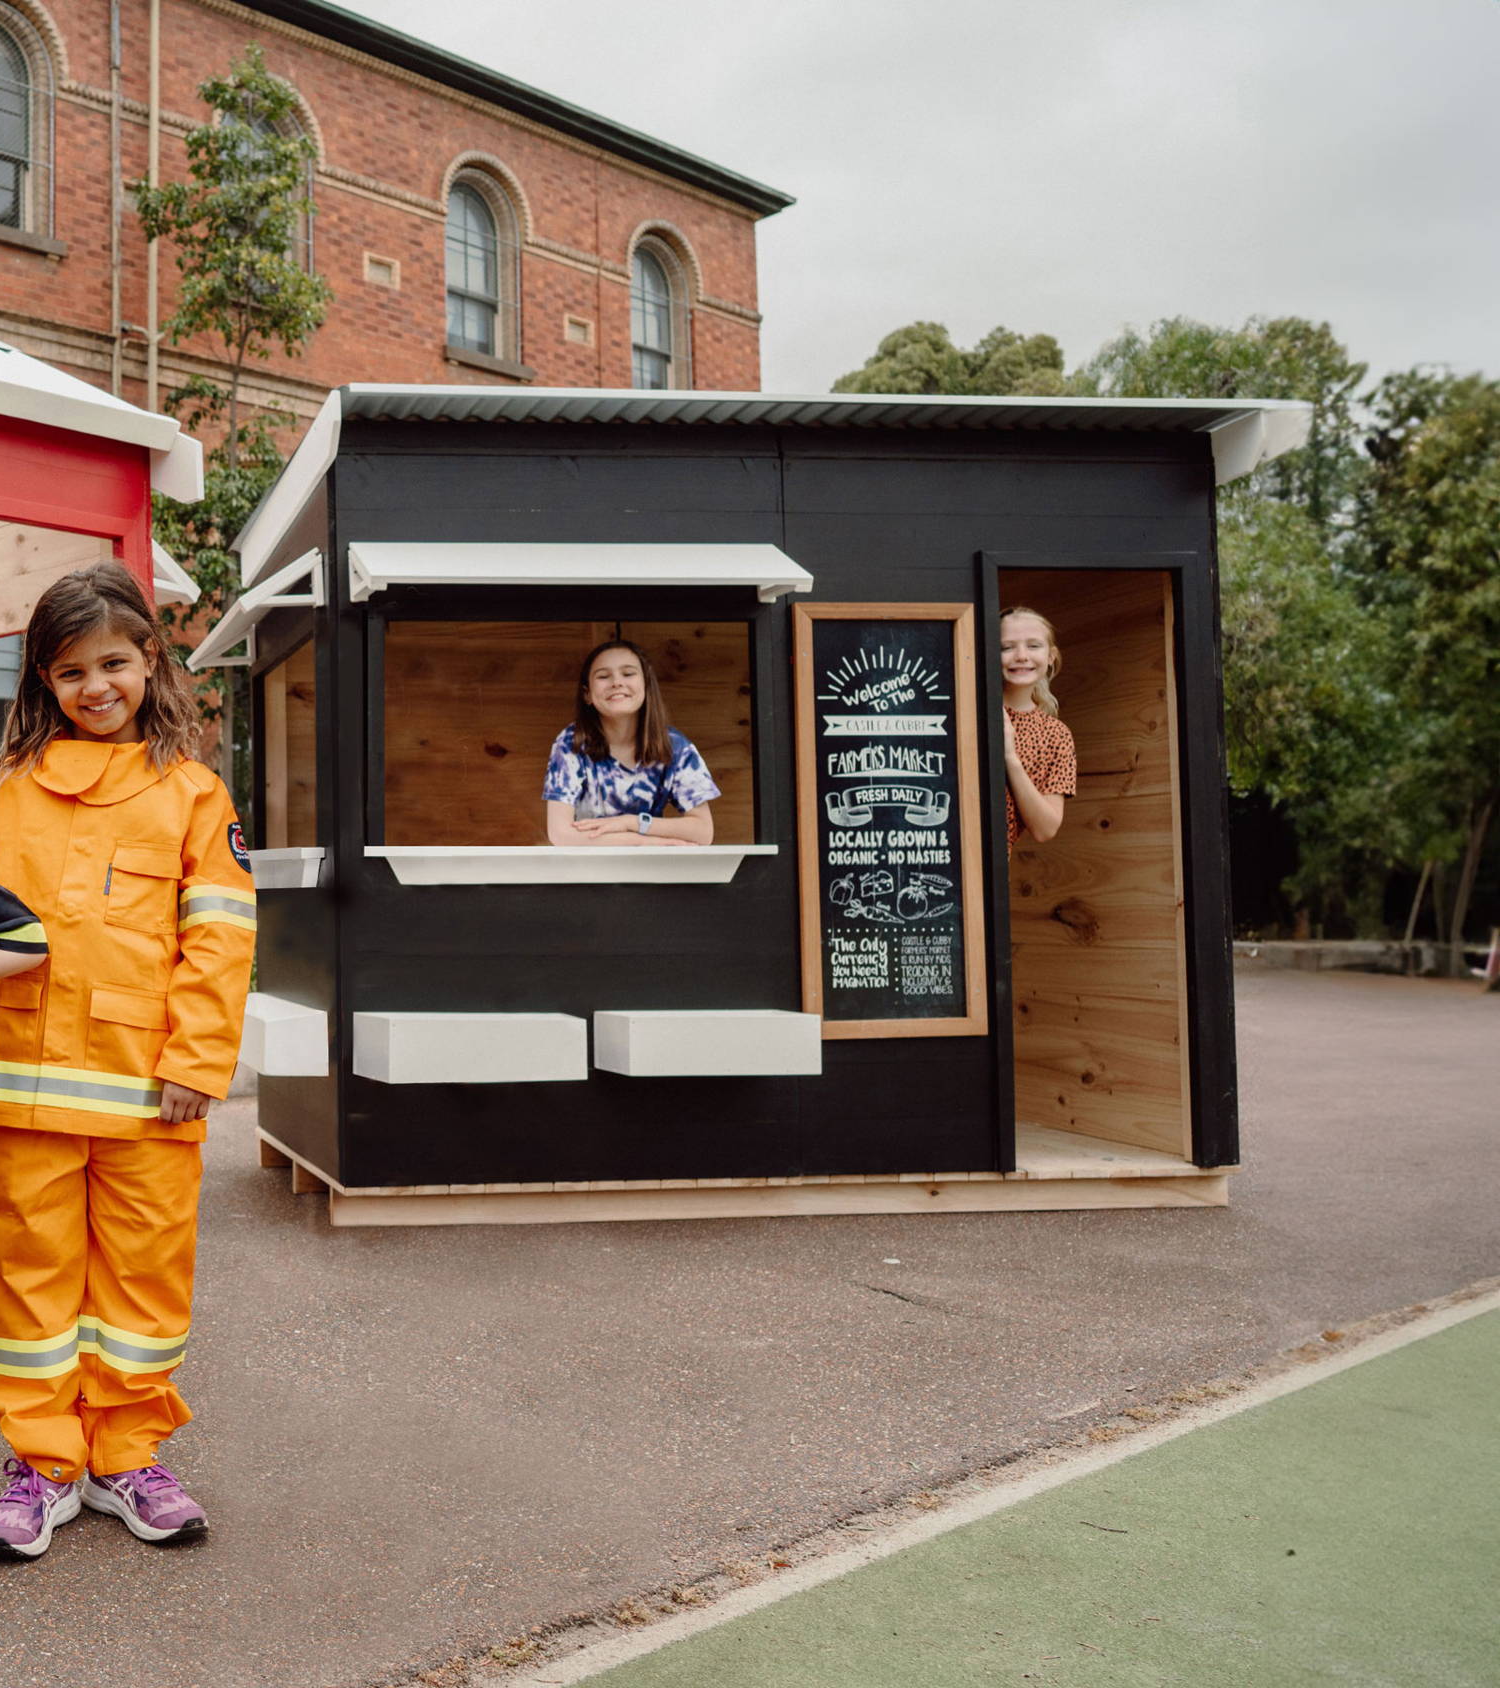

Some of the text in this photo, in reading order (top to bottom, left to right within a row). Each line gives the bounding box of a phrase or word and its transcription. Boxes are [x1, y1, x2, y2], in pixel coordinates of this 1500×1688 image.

[842, 673, 910, 706] Welcome
[869, 689, 915, 713] To The
[889, 745, 946, 775] MARKET
[855, 788, 923, 804] FRESH DAILY
[829, 830, 949, 848] LOCALLY GROWN &
[828, 850, 951, 865] ORGANIC NO NASTIES
[831, 936, 888, 955] The Only
[831, 952, 888, 968] Currency
[852, 964, 878, 976] Need
[941, 965, 952, 977] IN
[903, 985, 954, 995] GOOD VIBES
